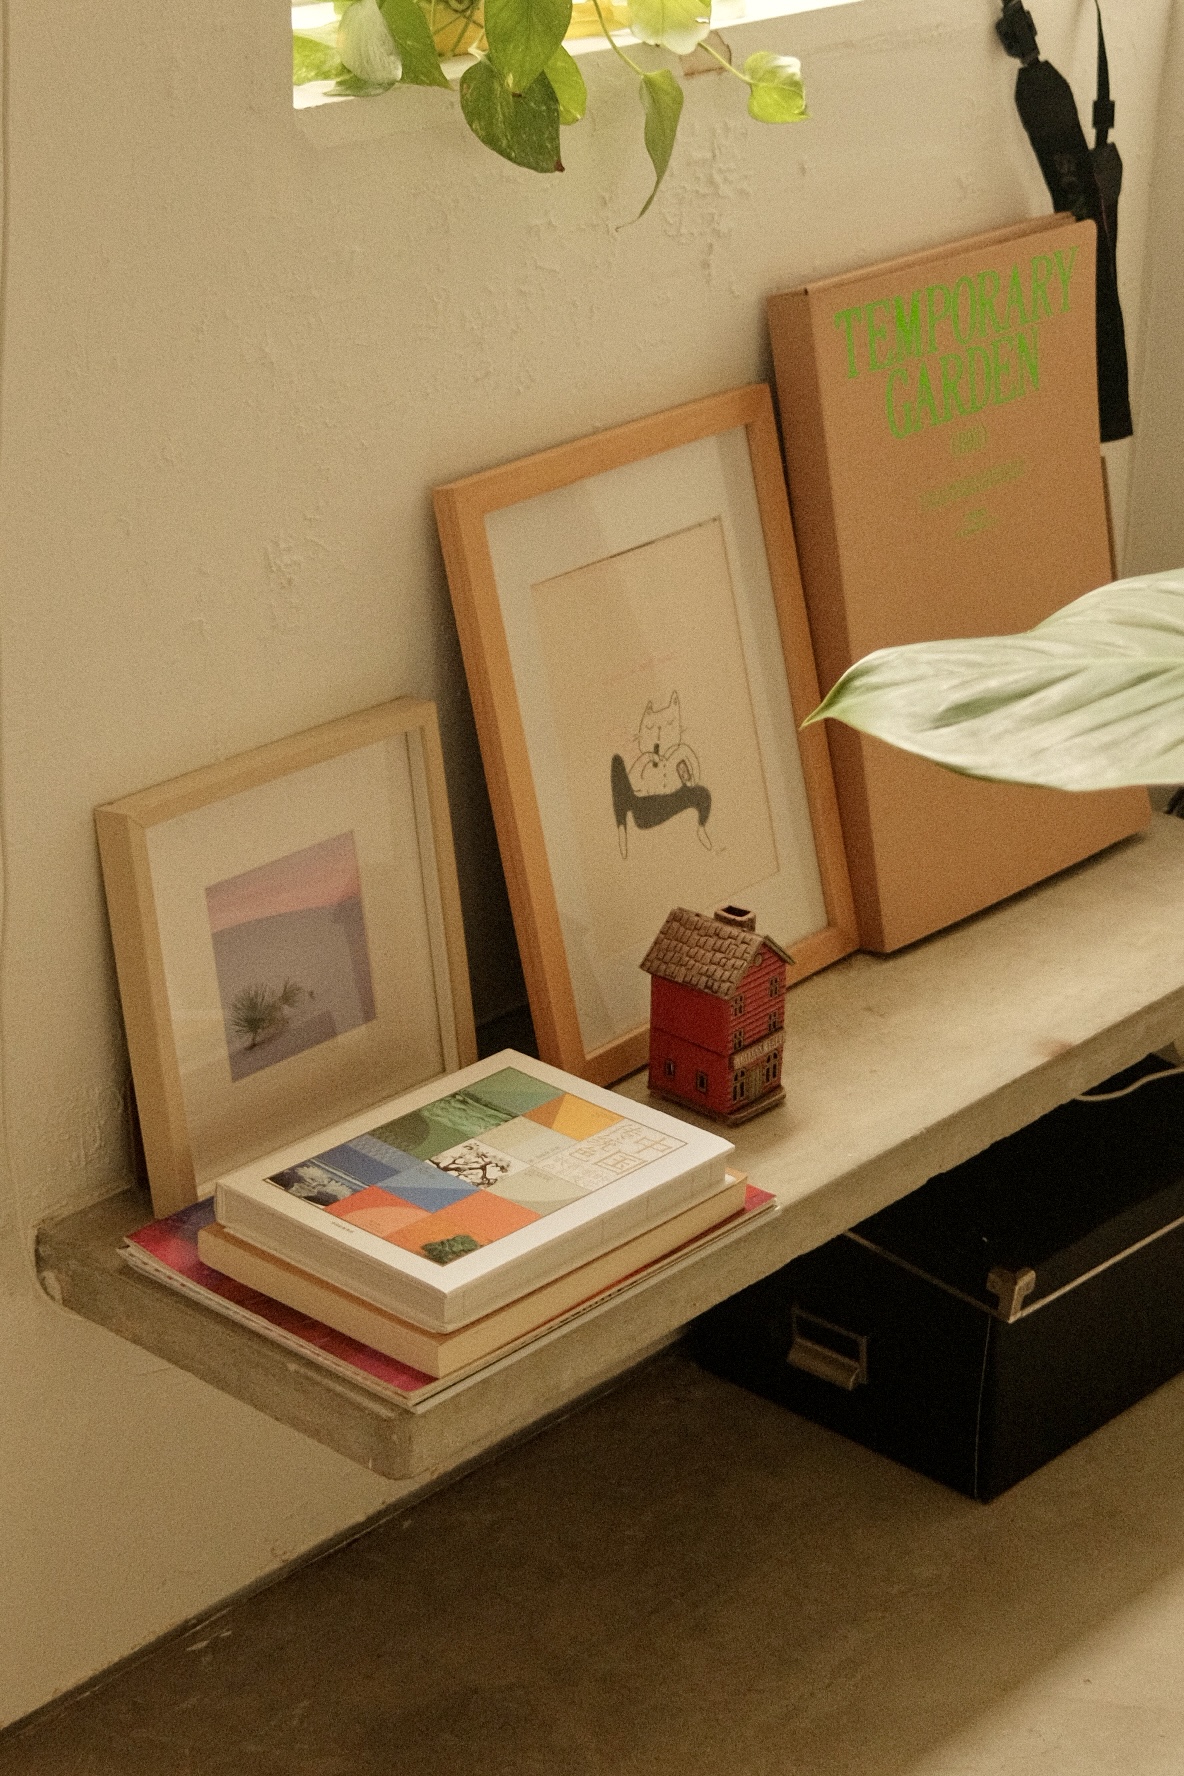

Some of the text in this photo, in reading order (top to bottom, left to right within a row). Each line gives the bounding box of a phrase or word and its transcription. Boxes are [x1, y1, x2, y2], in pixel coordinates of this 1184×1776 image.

[833, 245, 1080, 379] TEMPORARY
[885, 325, 1040, 440] GARDEN
[592, 1136, 673, 1176] 中国
